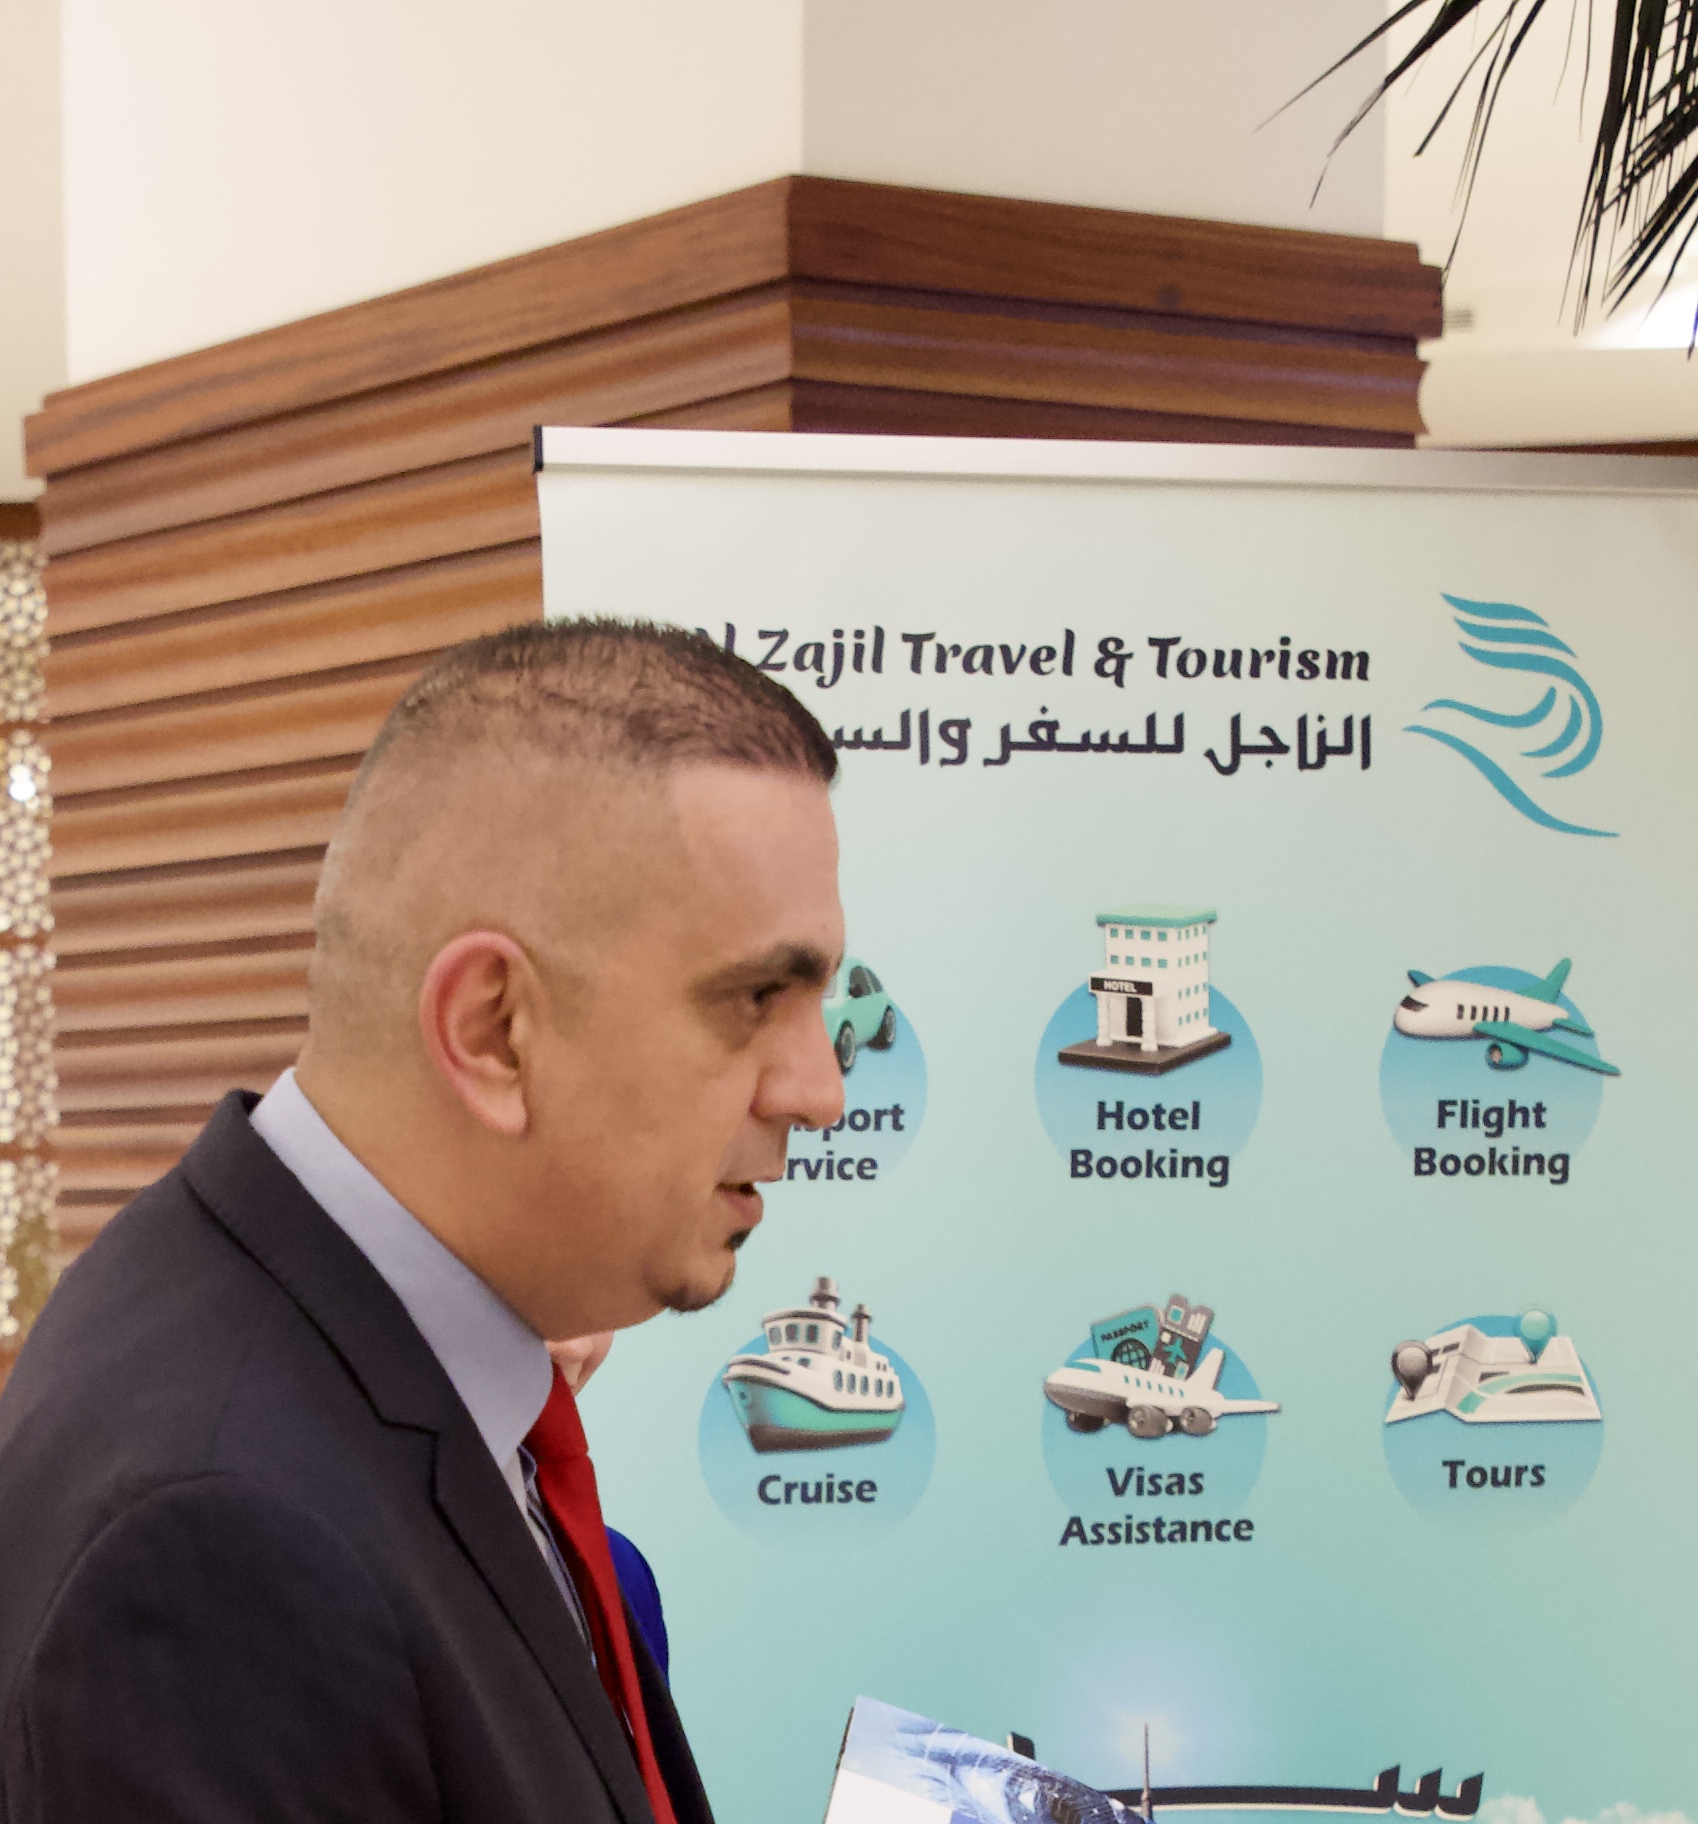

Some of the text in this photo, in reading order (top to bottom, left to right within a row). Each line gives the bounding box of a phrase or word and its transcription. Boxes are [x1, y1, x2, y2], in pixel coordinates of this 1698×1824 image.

[757, 625, 885, 689] Zajil
[901, 628, 1075, 676] Travel
[1094, 637, 1134, 688] &
[1147, 636, 1370, 681] Tourism
[982, 705, 1184, 768] للسفر
[1203, 711, 1371, 776] الزاجل
[1104, 980, 1137, 993] HOTEL
[1097, 1100, 1200, 1131] Hotel
[1437, 1099, 1547, 1138] Flight
[786, 1150, 879, 1181] rvice
[1070, 1148, 1230, 1188] Booking
[1414, 1146, 1570, 1185] Booking
[757, 1473, 878, 1505] Cruise
[1106, 1467, 1204, 1497] Visas
[1441, 1459, 1545, 1489] Tours
[1059, 1514, 1255, 1546] Assistance
